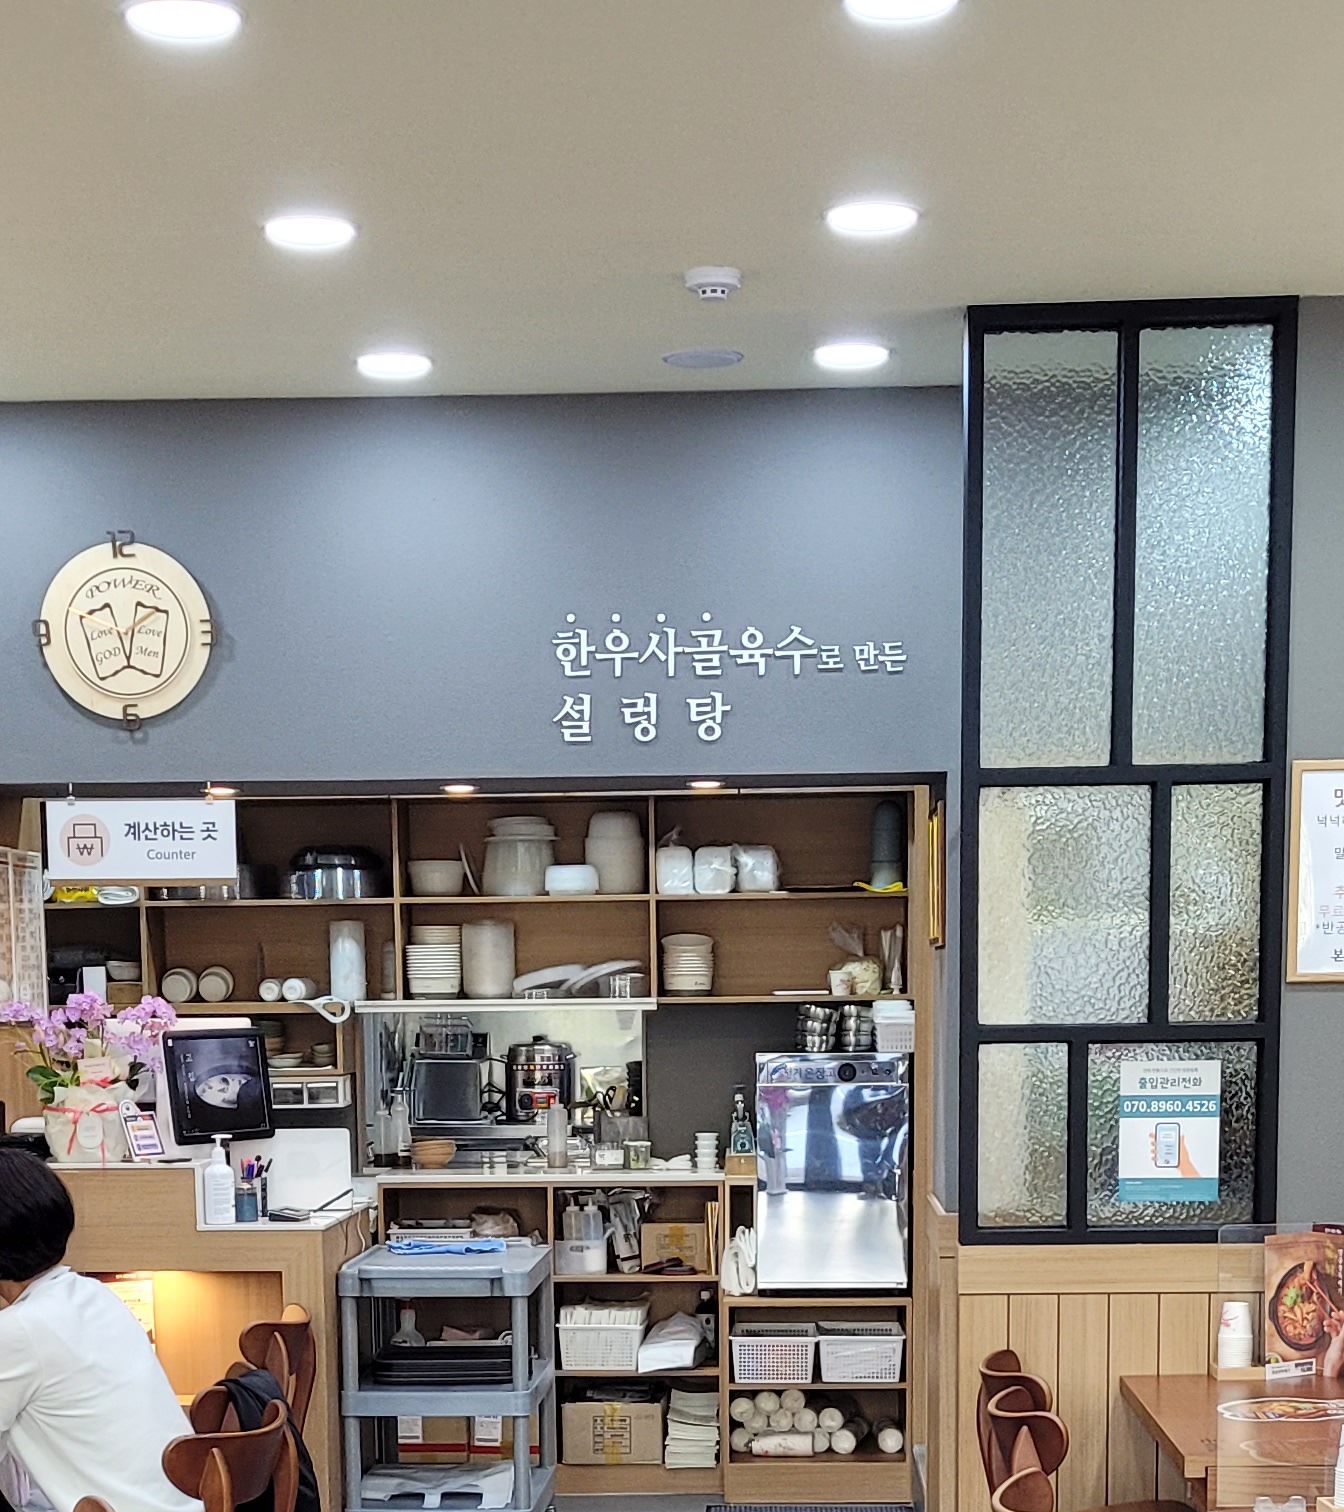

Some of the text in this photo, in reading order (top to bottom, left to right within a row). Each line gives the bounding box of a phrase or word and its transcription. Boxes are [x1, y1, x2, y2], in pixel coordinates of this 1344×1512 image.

[106, 529, 136, 559] 12
[86, 575, 162, 601] POWER
[90, 627, 114, 642] Love
[136, 625, 163, 638] Love
[96, 646, 121, 666] GOD
[135, 646, 159, 659] Men
[552, 622, 908, 677] 한우사골육수로 만든
[123, 821, 218, 842] 계산하는 곳
[146, 848, 197, 861] Counter
[1319, 905, 1344, 917] 무료
[1138, 1077, 1202, 1090] 출입관리전화
[1124, 1100, 1216, 1113] 070.8960.4526
